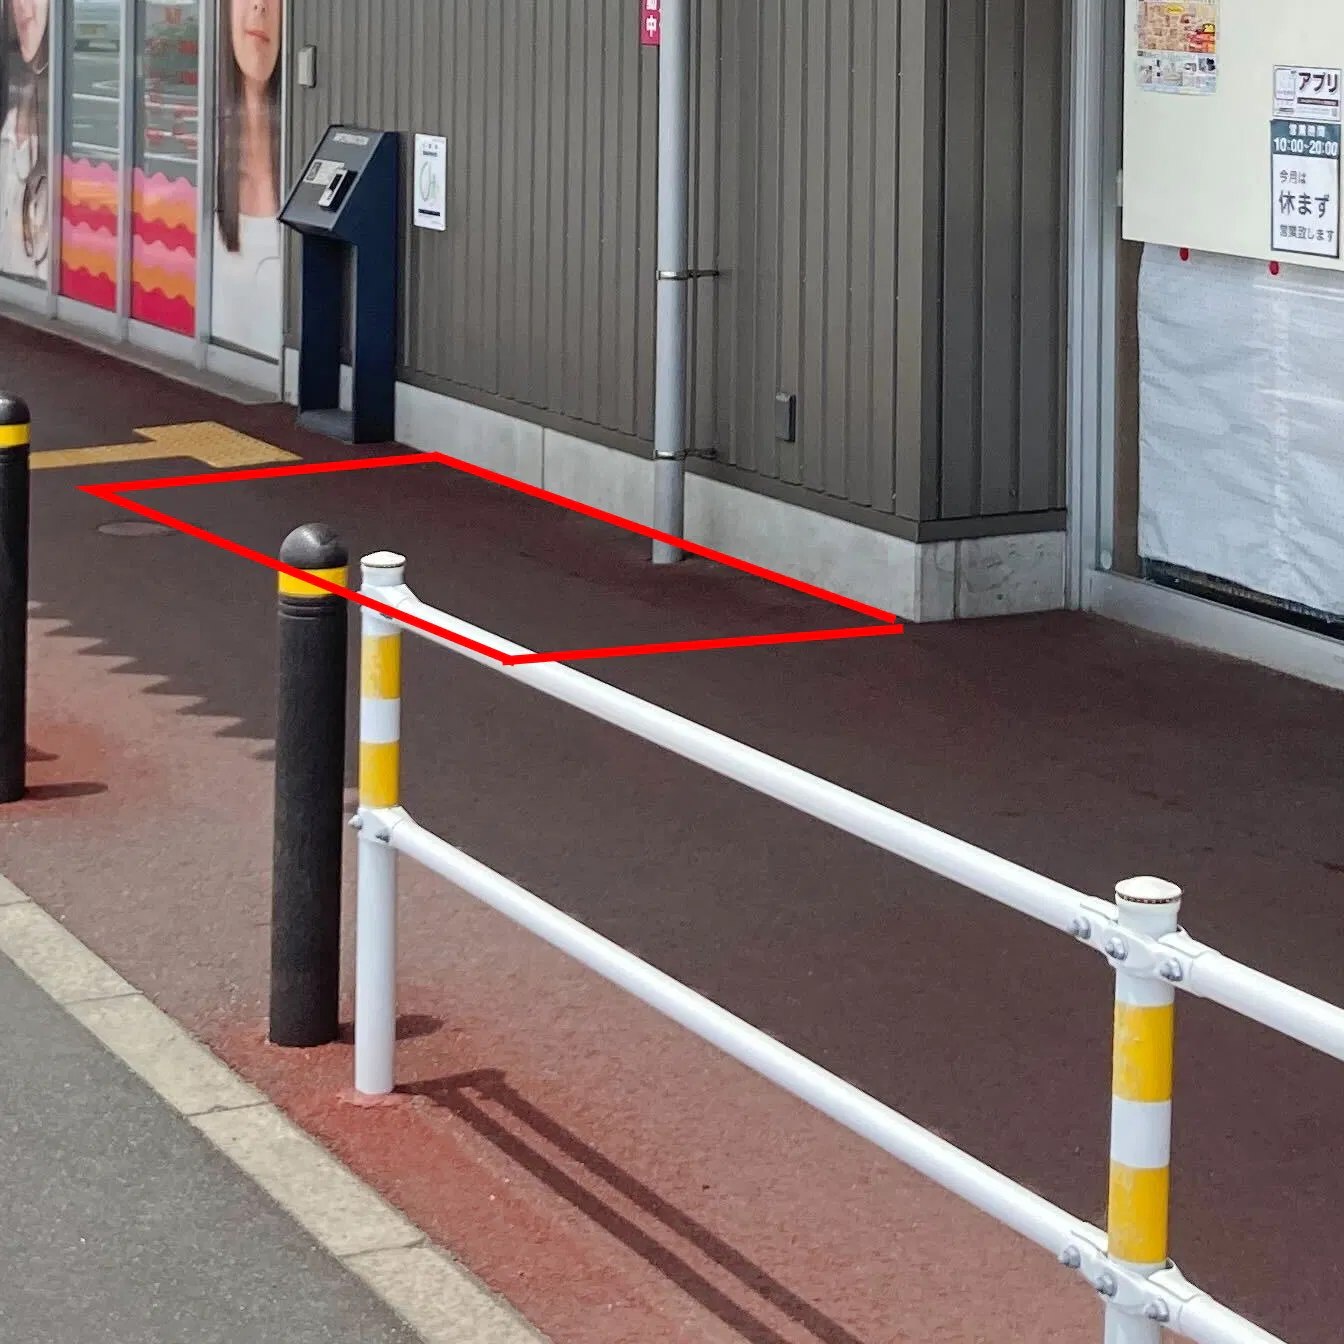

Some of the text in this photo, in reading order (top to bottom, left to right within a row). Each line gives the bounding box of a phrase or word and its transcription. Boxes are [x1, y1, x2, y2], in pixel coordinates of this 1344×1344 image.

[1298, 72, 1338, 93] アプリ
[1279, 169, 1307, 184] 今月は
[1278, 190, 1331, 218] 休まず
